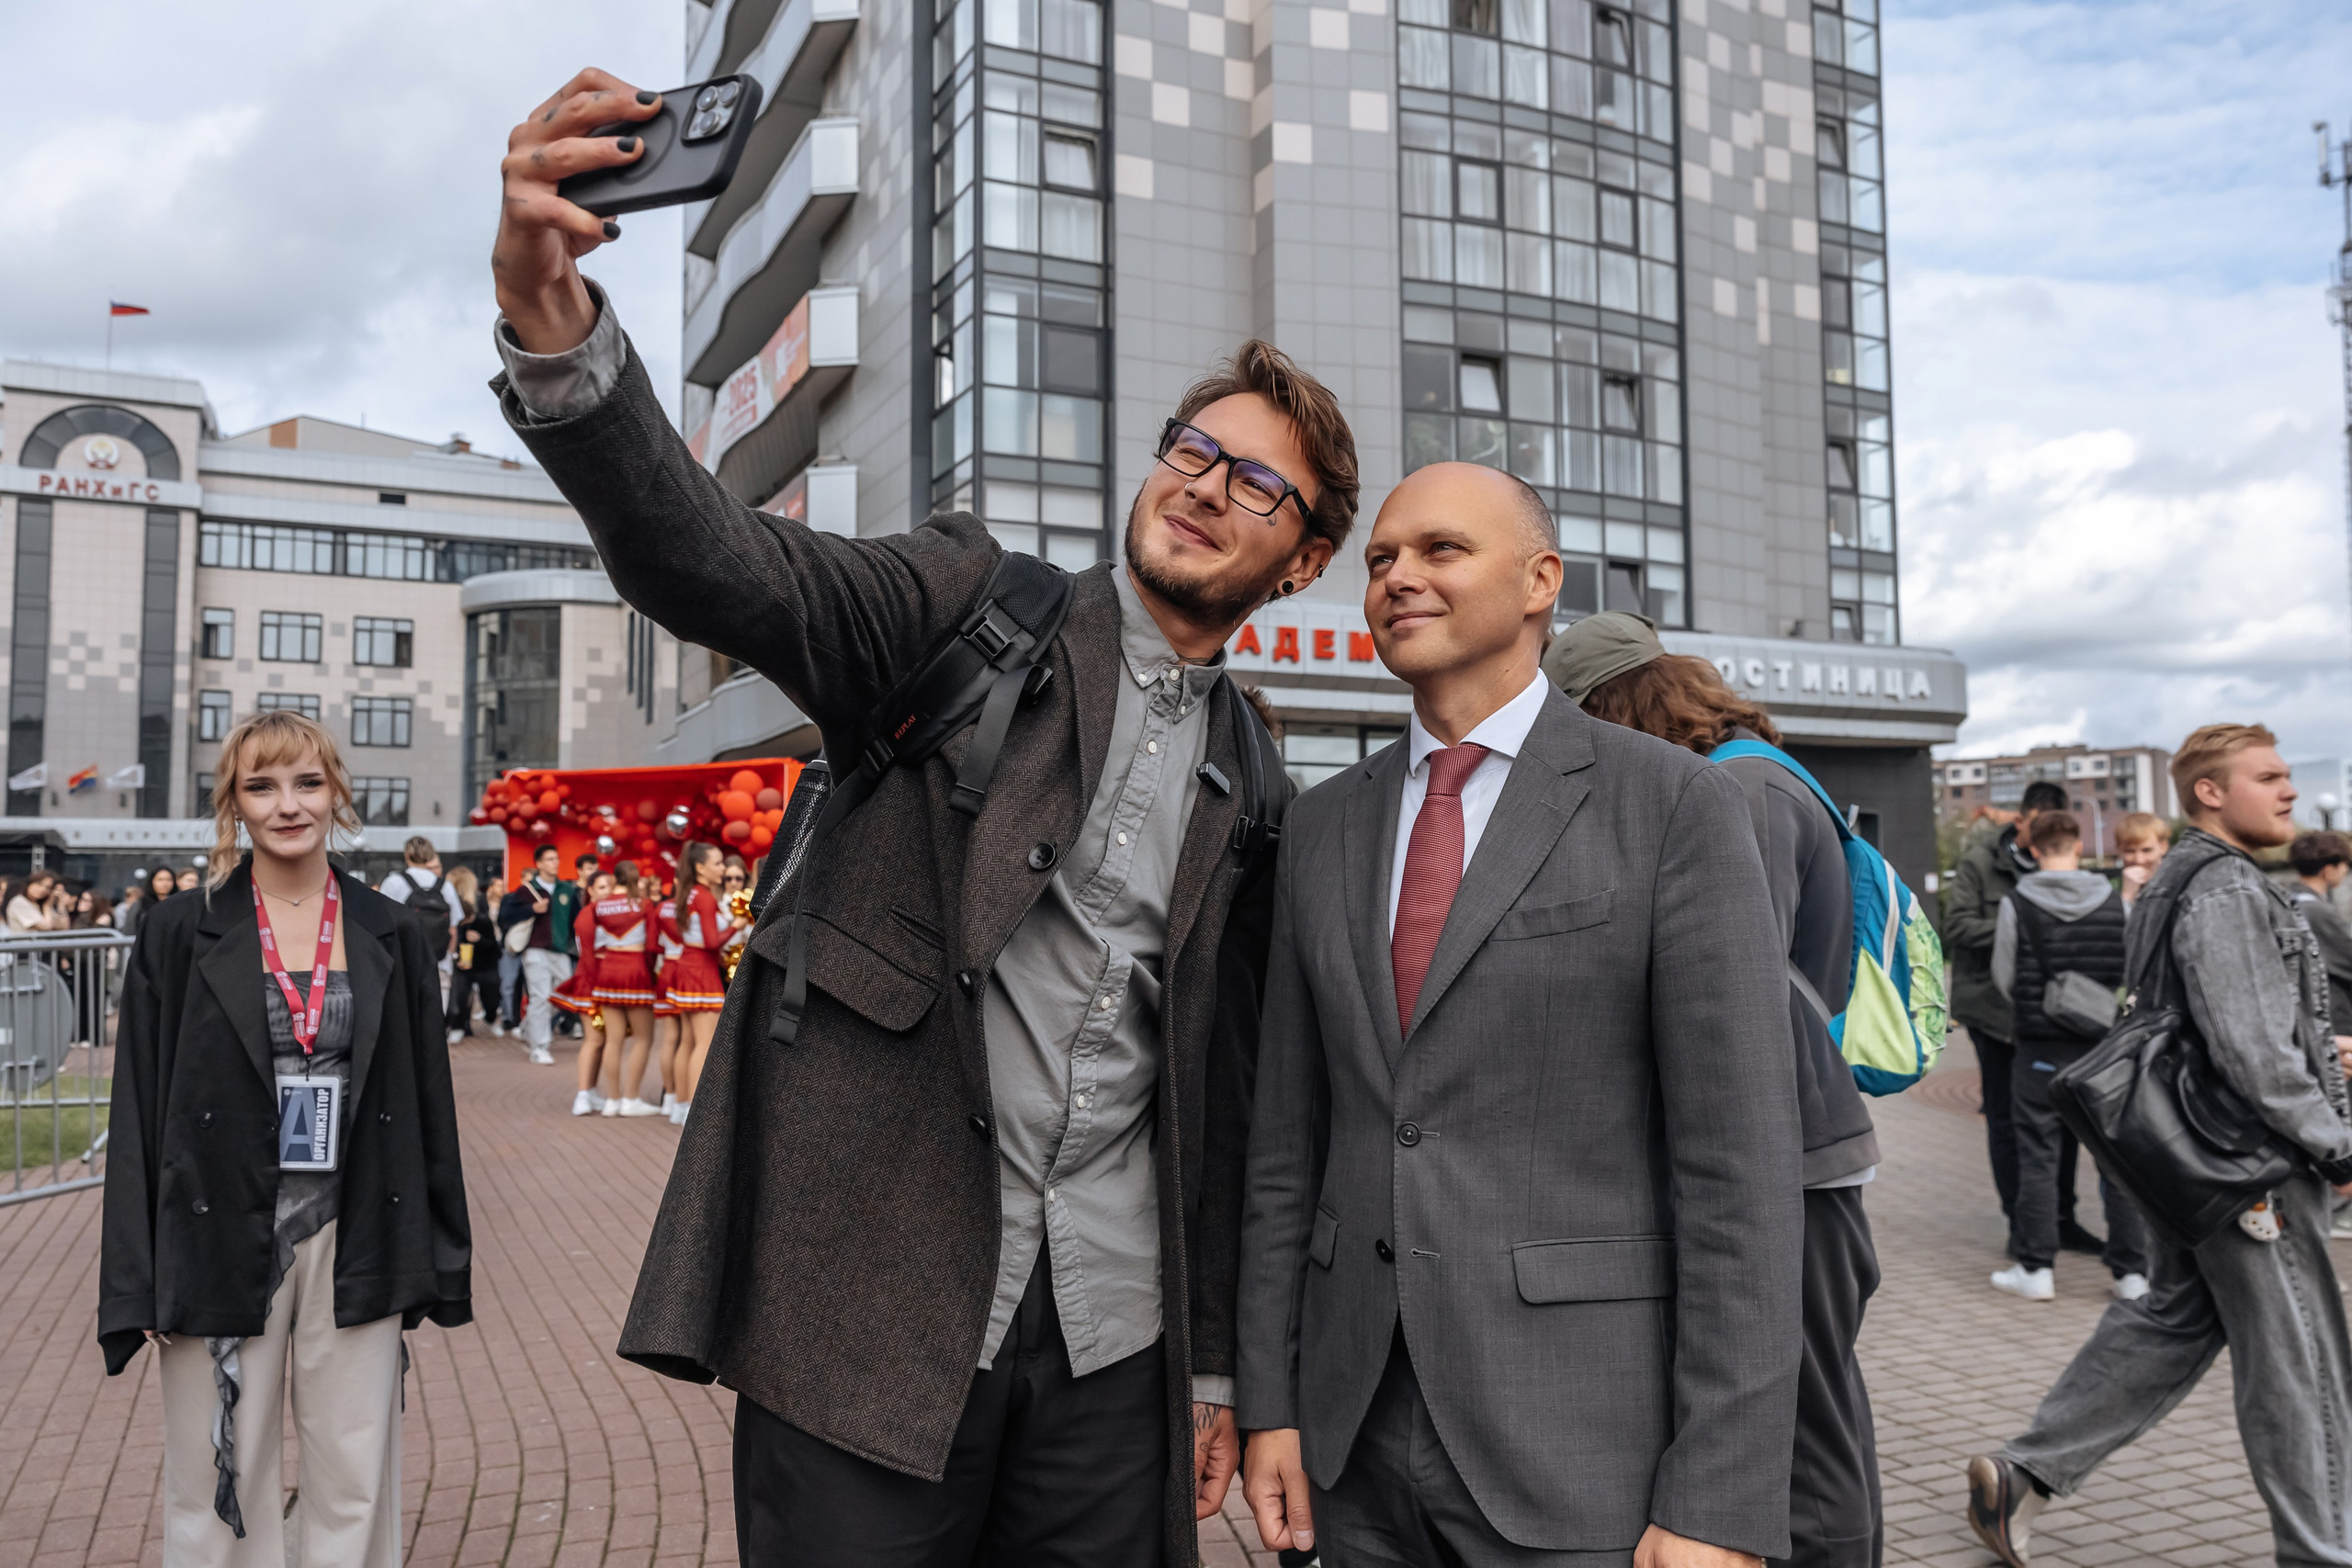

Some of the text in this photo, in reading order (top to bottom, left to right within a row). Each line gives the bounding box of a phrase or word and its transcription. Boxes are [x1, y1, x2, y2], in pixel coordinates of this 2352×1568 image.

[39, 474, 159, 502] РАНХиГС
[1233, 623, 1374, 663] АДЕМ
[1714, 656, 1931, 702] ОСТИНИЦА
[894, 714, 916, 739] REPLAY
[313, 1089, 330, 1160] ОРГАНИЗАТОР
